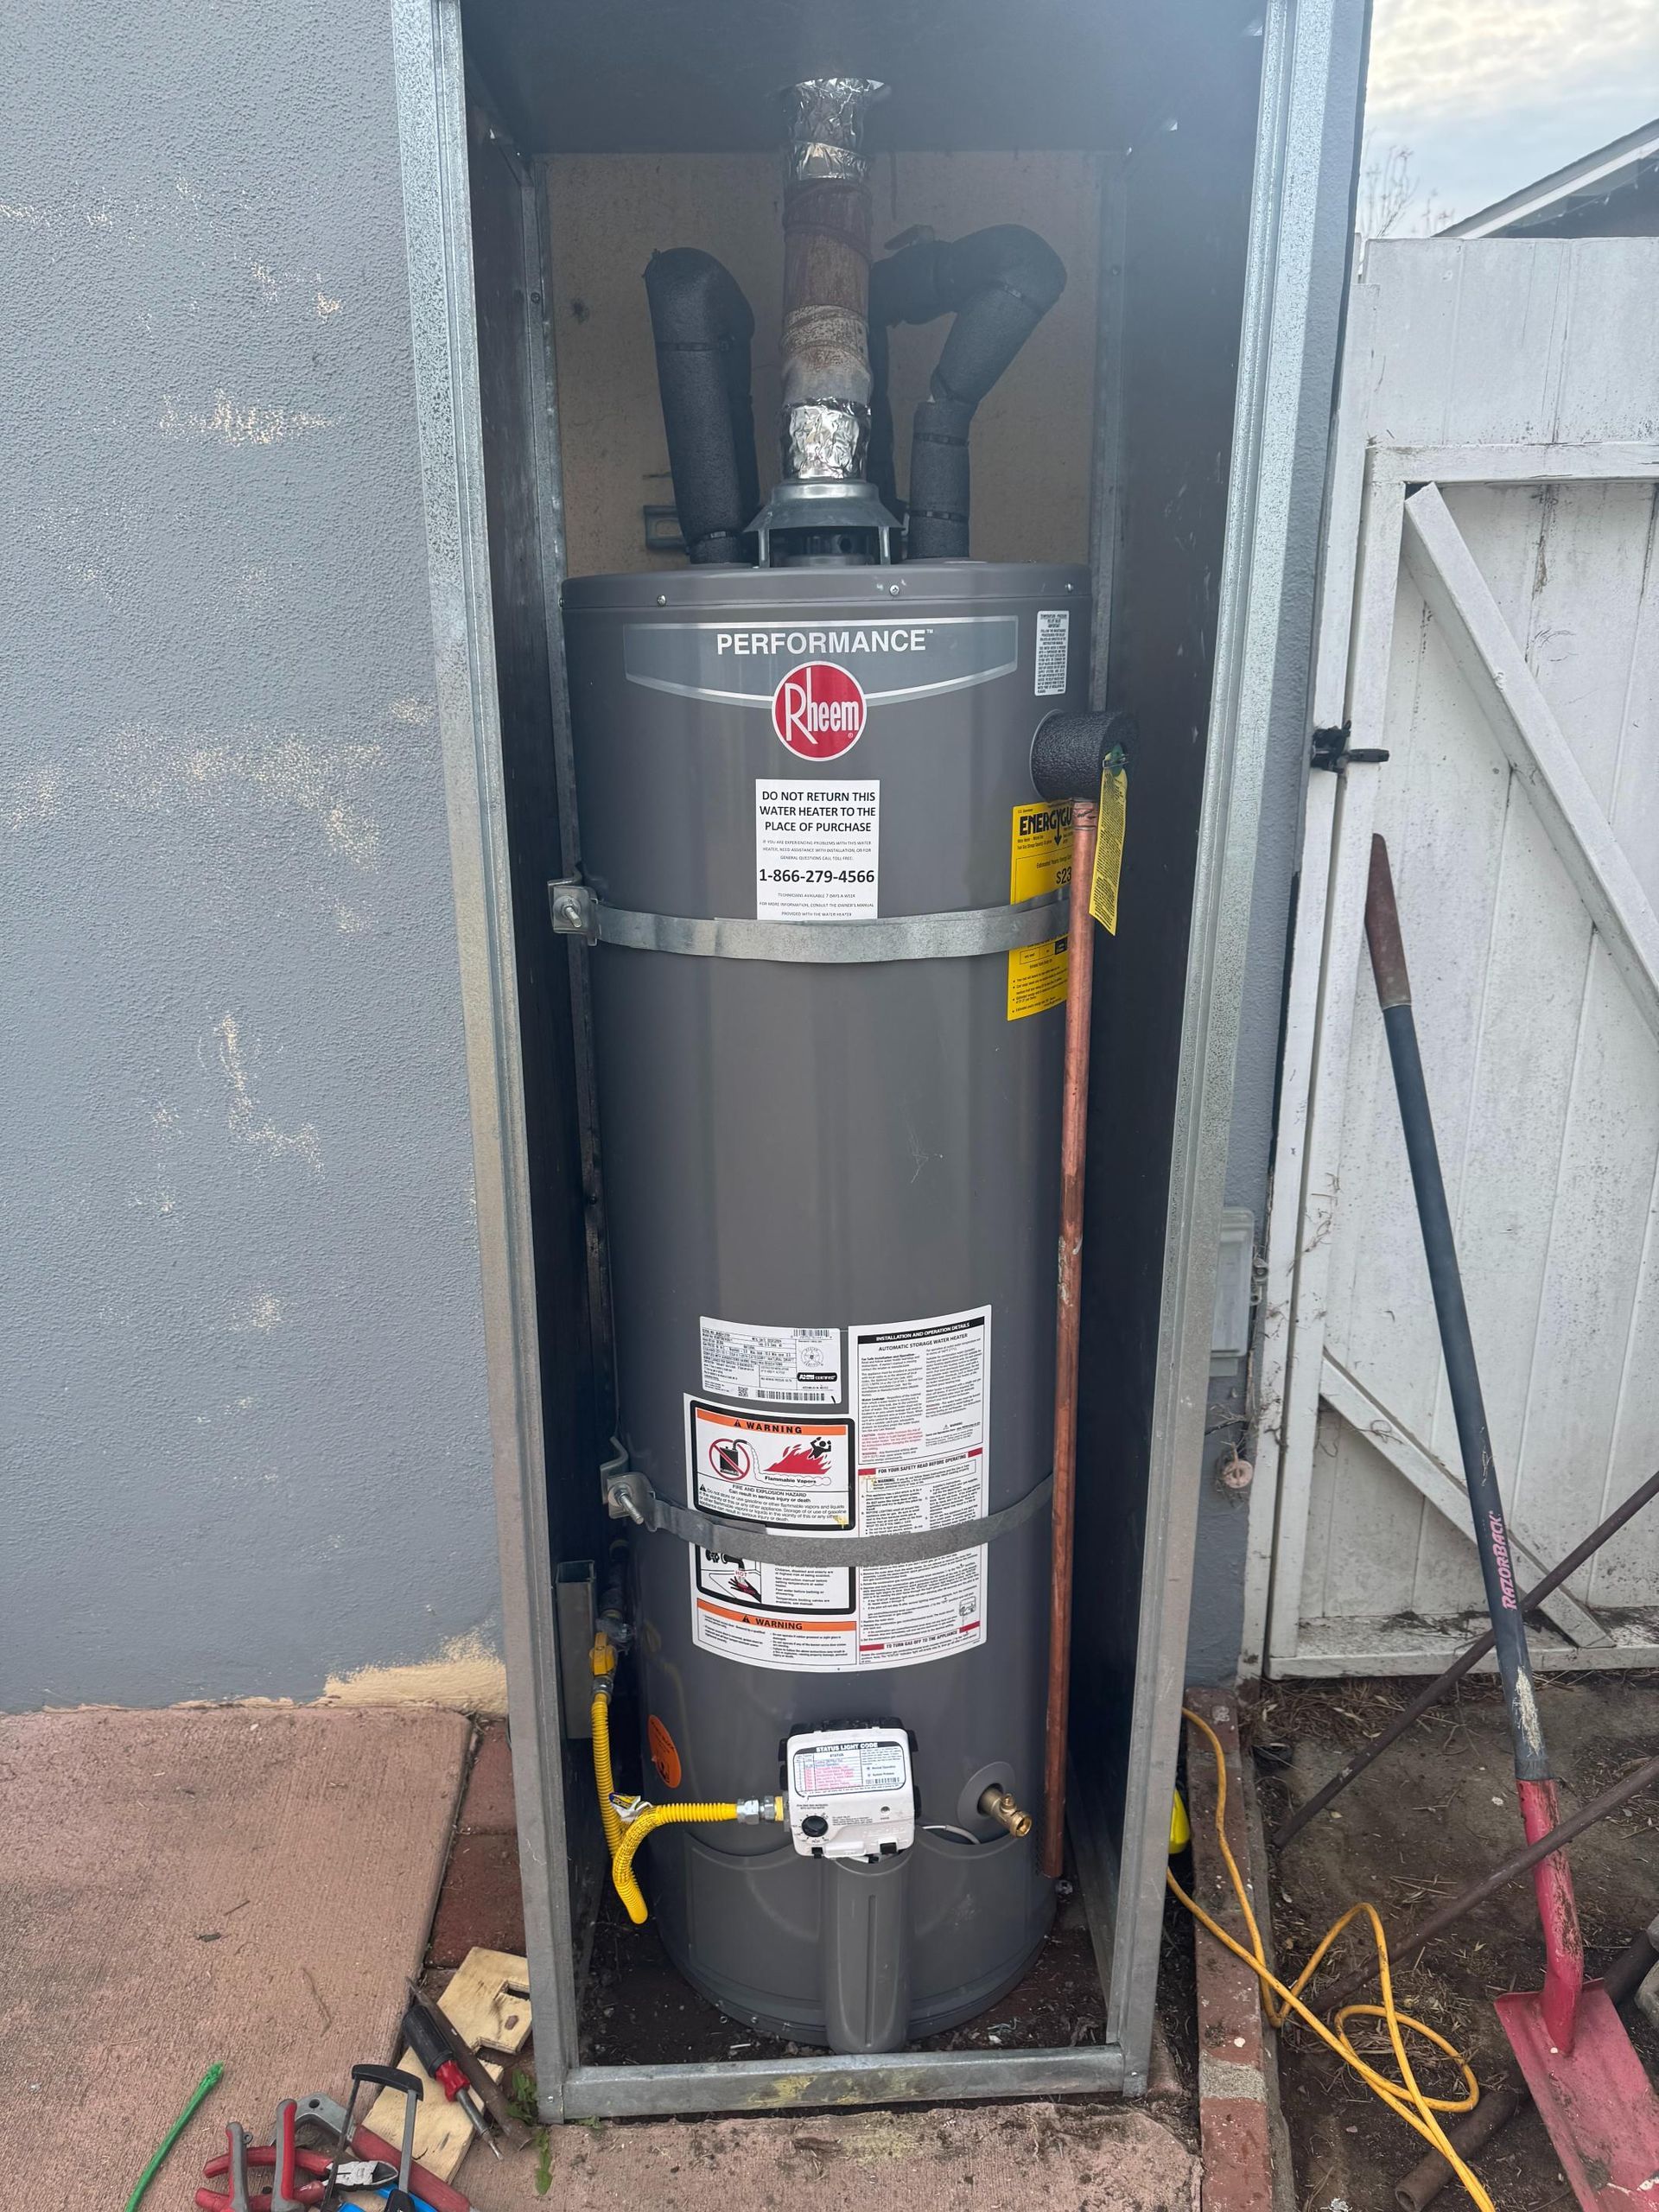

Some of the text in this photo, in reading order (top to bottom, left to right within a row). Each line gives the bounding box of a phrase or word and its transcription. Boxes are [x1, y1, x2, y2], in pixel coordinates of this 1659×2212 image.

[785, 668, 859, 744] Rheem
[762, 791, 875, 801] DO NOT RETURN THIS
[760, 806, 875, 817] WATER HEATER TO THE
[766, 822, 871, 831] PLACE OF PURCHASE
[1020, 806, 1071, 836] ENERGYGU
[760, 868, 874, 883] 1-866-279-4566
[925, 1327, 950, 1336] OPERATION
[950, 1333, 968, 1342] HEATER
[747, 1421, 802, 1433] WARNING
[945, 1454, 966, 1464] OPERATING
[714, 1499, 734, 1509] flammable
[755, 1618, 803, 1630] WARNING
[937, 1630, 957, 1641] APPLIANCE
